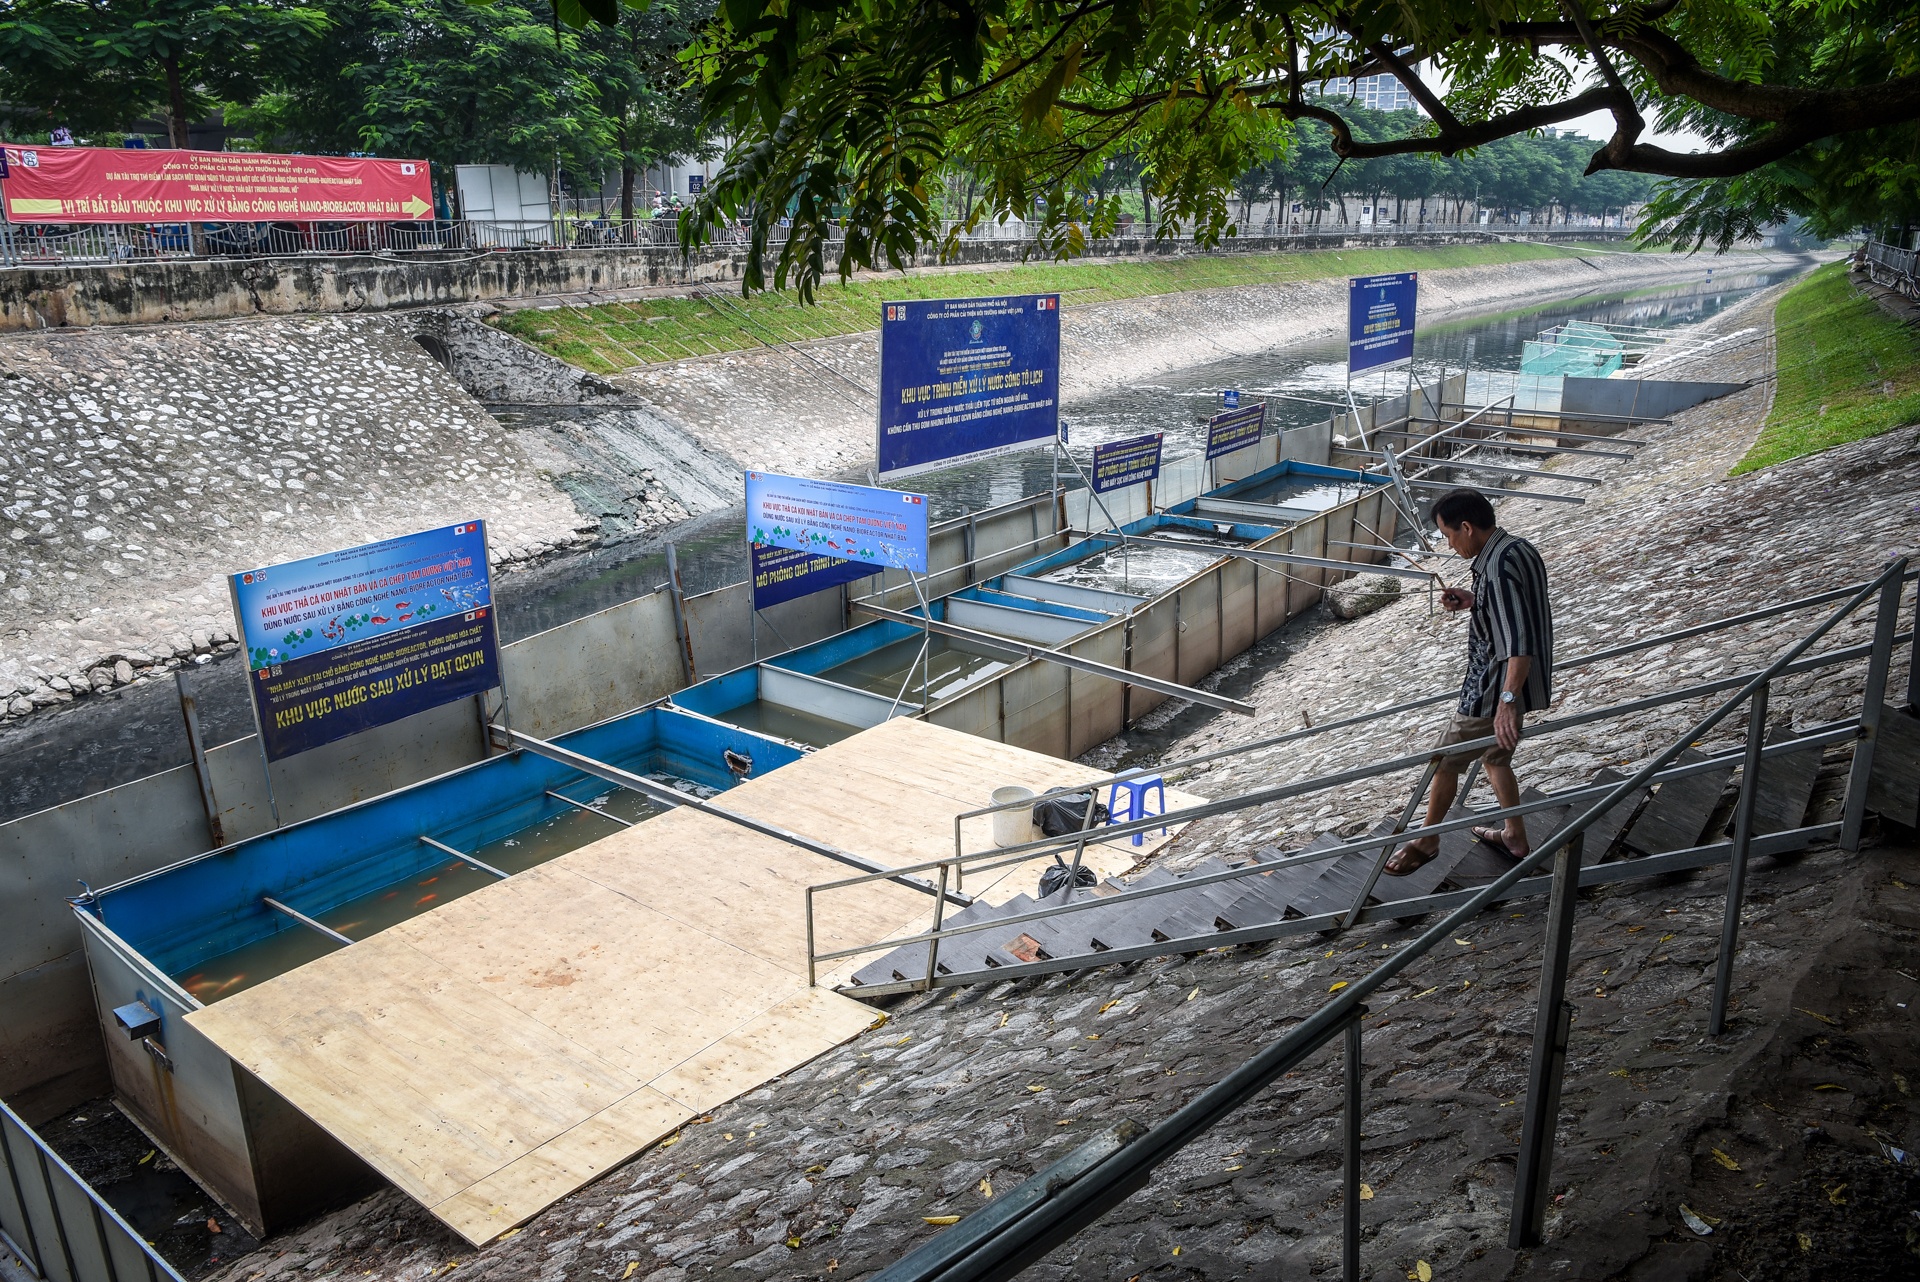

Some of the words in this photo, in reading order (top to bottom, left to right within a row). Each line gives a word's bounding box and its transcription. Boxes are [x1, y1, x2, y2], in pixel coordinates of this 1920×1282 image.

[189, 161, 198, 170] CỔ
[199, 162, 215, 170] PHẦN
[190, 154, 197, 162] ỦY
[260, 156, 270, 164] PHỐ
[63, 199, 75, 216] VỊ
[75, 196, 90, 212] TRÍ
[92, 193, 109, 212] BẮT
[111, 193, 130, 212] ĐẦU
[131, 196, 162, 216] THUỘC
[164, 200, 182, 212] KHU
[185, 199, 202, 215] VỰC
[204, 195, 215, 212] XỬ
[216, 196, 226, 212] LÝ
[227, 194, 250, 212] BẰNG
[251, 197, 275, 212] CÔNG
[277, 198, 299, 215] NGHỆ
[299, 200, 366, 212] NANO-BIOREACTOR
[366, 199, 385, 215] NHẬT
[385, 197, 399, 212] BẢN
[901, 387, 915, 403] KHU
[917, 384, 930, 404] VỰC
[931, 379, 951, 399] TRÌNH
[952, 374, 967, 395] DIỄN
[968, 374, 977, 393] XỬ
[978, 374, 986, 391] LÝ
[987, 372, 1003, 390] NƯỚC
[1004, 370, 1020, 387] SÔNG
[1021, 368, 1028, 385] TÔ
[1029, 369, 1042, 386] LỊCH
[261, 604, 277, 618] KHU
[277, 600, 293, 615] VỰC
[293, 595, 308, 610] THẢ
[309, 593, 319, 605] CÁ
[320, 591, 332, 602] KOI
[333, 584, 352, 601] NHẬT
[352, 580, 367, 594] BẢN
[368, 579, 378, 590] VÀ
[378, 576, 387, 588] CÁ
[388, 572, 406, 585] CHÉP
[407, 569, 421, 580] TAM
[421, 563, 442, 577] DƯƠNG
[442, 558, 457, 573] VIỆT
[457, 556, 471, 568] NAM
[756, 570, 767, 588] MÔ
[769, 562, 793, 584] PHỎNG
[794, 559, 808, 577] QUÁ
[809, 553, 829, 572] TRÌNH
[263, 617, 282, 630] DÙNG
[283, 612, 302, 625] NƯỚC
[303, 610, 316, 620] SAU
[316, 605, 326, 616] XỬ
[327, 603, 336, 614] LÝ
[336, 597, 354, 611] BẰNG
[355, 594, 372, 606] CÔNG
[373, 590, 389, 603] NGHỆ
[390, 577, 444, 597] NANO-BIOREACTOR
[445, 571, 460, 584] NHẬT
[460, 566, 473, 579] BẢN
[275, 704, 304, 728] KHU
[305, 695, 333, 722] VỰC
[332, 682, 368, 710] NƯỚC
[368, 677, 393, 698] SAU
[394, 666, 413, 690] XỬ
[413, 663, 429, 684] LÝ
[430, 658, 453, 682] ĐẠT
[454, 649, 484, 672] QCVN
